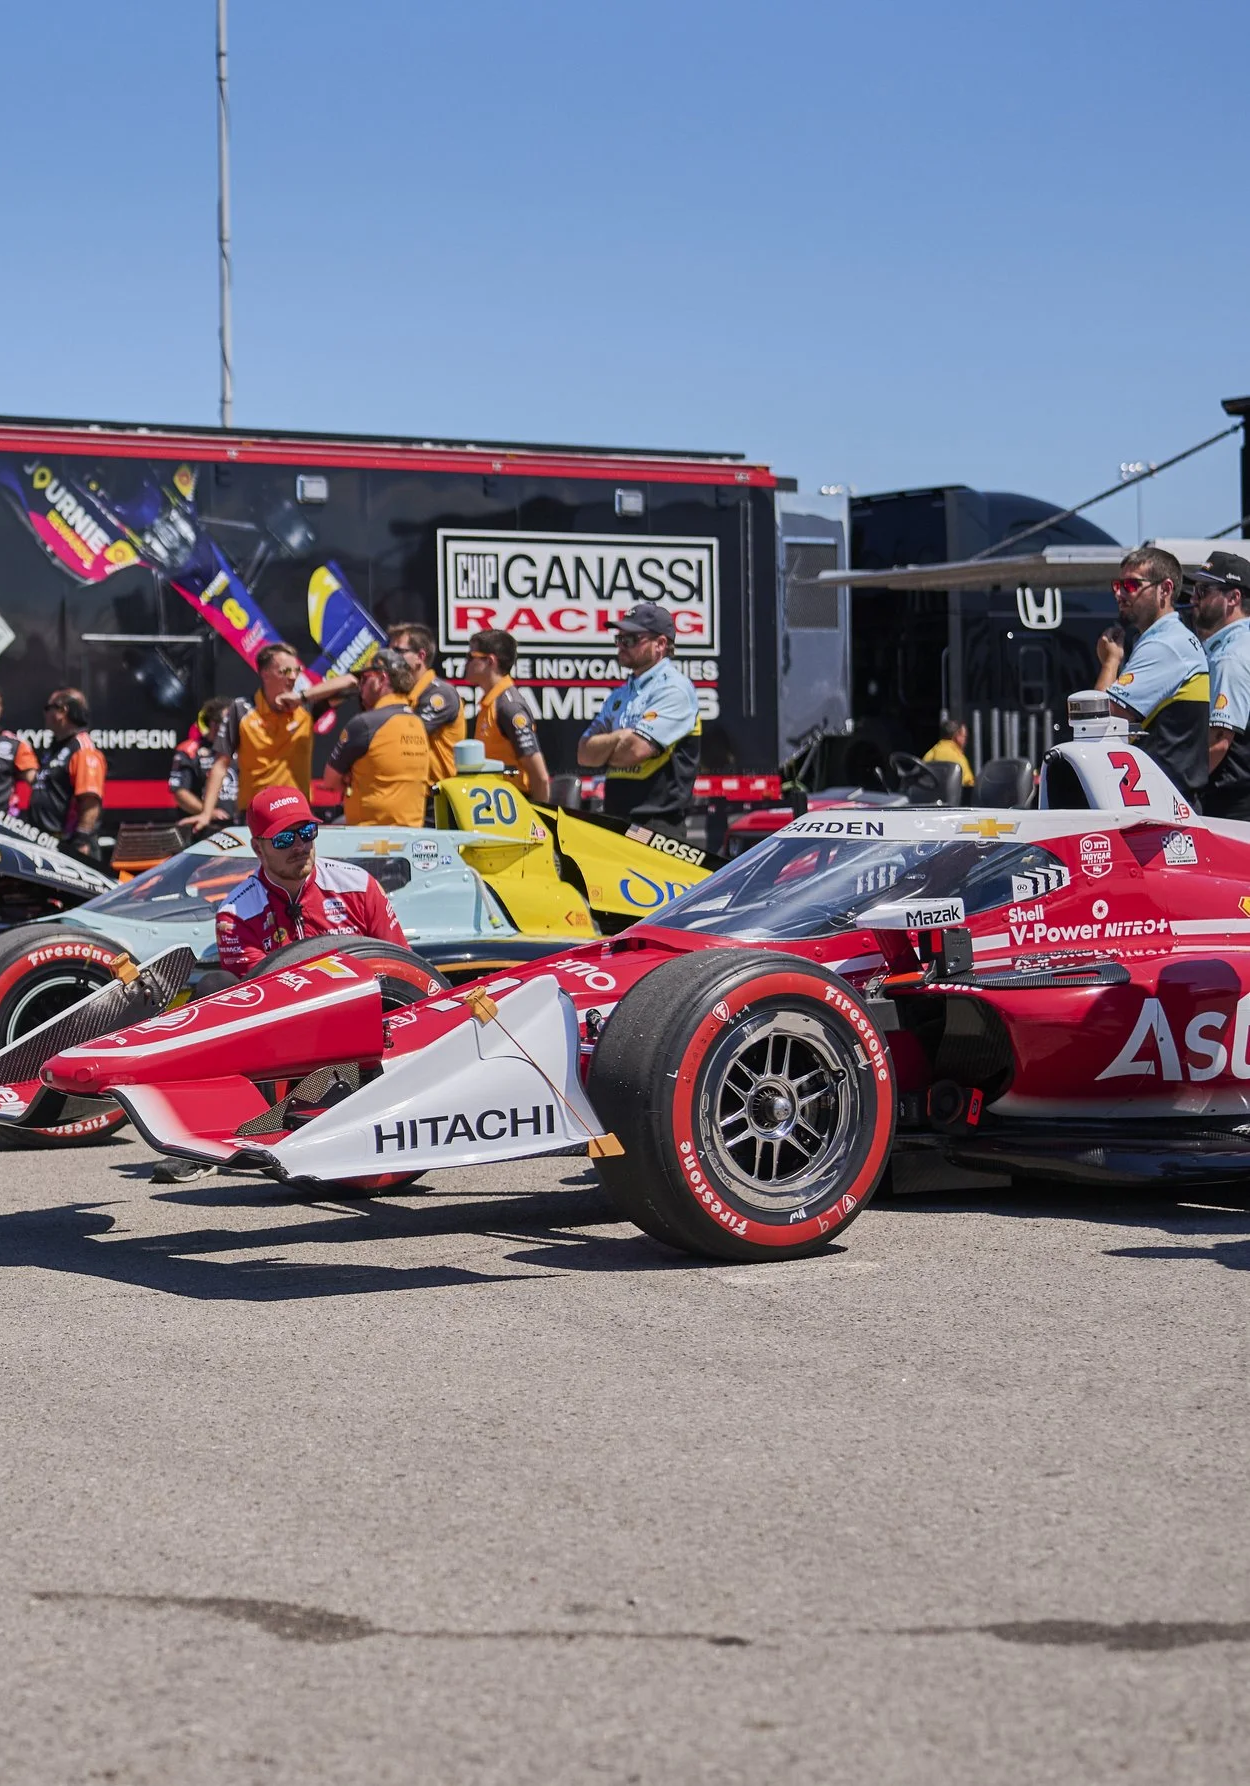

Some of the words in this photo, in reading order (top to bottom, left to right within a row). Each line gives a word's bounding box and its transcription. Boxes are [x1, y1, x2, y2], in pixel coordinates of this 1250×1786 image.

[456, 552, 498, 599] CHIP
[504, 553, 704, 602] GANASSI
[222, 598, 249, 631] 8
[454, 605, 704, 634] RACIG
[89, 729, 177, 750] SIMPSON
[1107, 751, 1150, 807] 2
[269, 796, 300, 812] Astemo
[468, 787, 518, 826] 20
[36, 831, 60, 852] OIL
[649, 833, 707, 867] ROSSI
[1081, 852, 1112, 861] INDYCAR
[905, 904, 962, 928] Mazak
[1008, 905, 1044, 923] Shell
[1010, 923, 1101, 946] V-Power
[27, 944, 112, 968] Firestone
[824, 985, 888, 1081] Firestone
[47, 1114, 111, 1136] Firesto
[373, 1104, 555, 1155] HITACHI
[679, 1140, 748, 1236] Firestone
